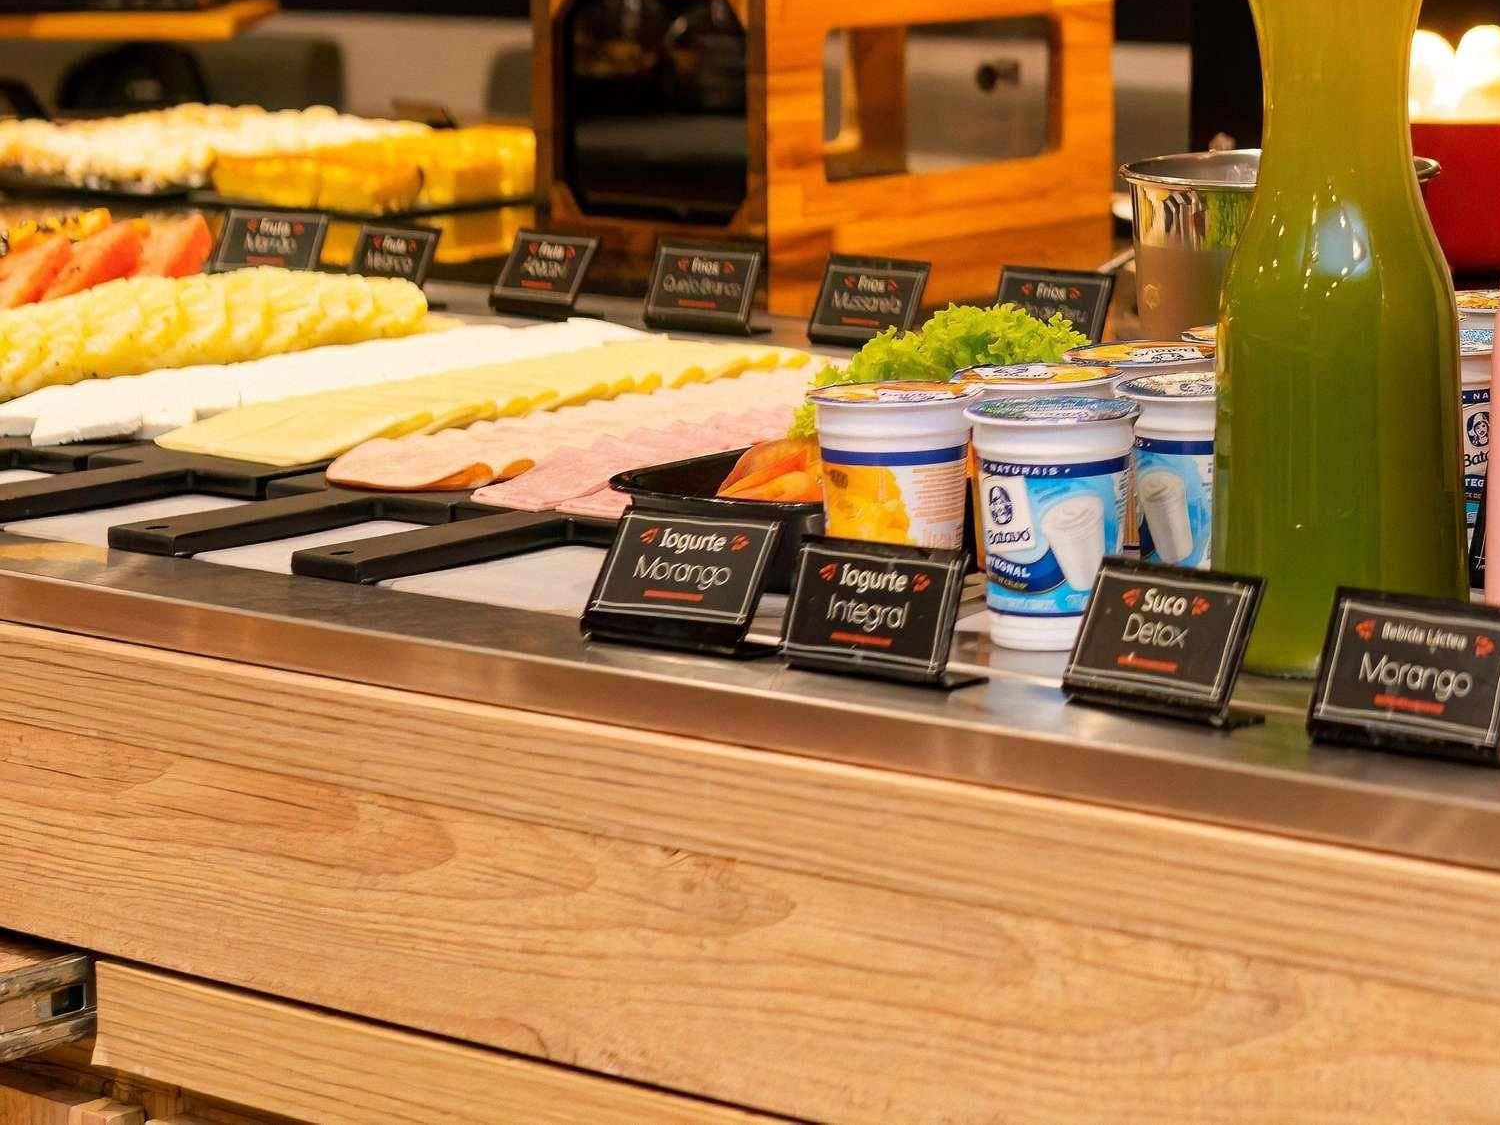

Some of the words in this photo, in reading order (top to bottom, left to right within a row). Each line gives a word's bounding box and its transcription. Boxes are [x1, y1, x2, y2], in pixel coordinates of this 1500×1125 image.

[658, 527, 728, 555] Iogurte
[632, 553, 732, 591] Morango
[839, 563, 911, 594] Iogurte
[825, 592, 911, 633] Integral
[1140, 587, 1189, 617] Suco
[1121, 612, 1190, 649] Detox
[1358, 651, 1474, 702] Morango
